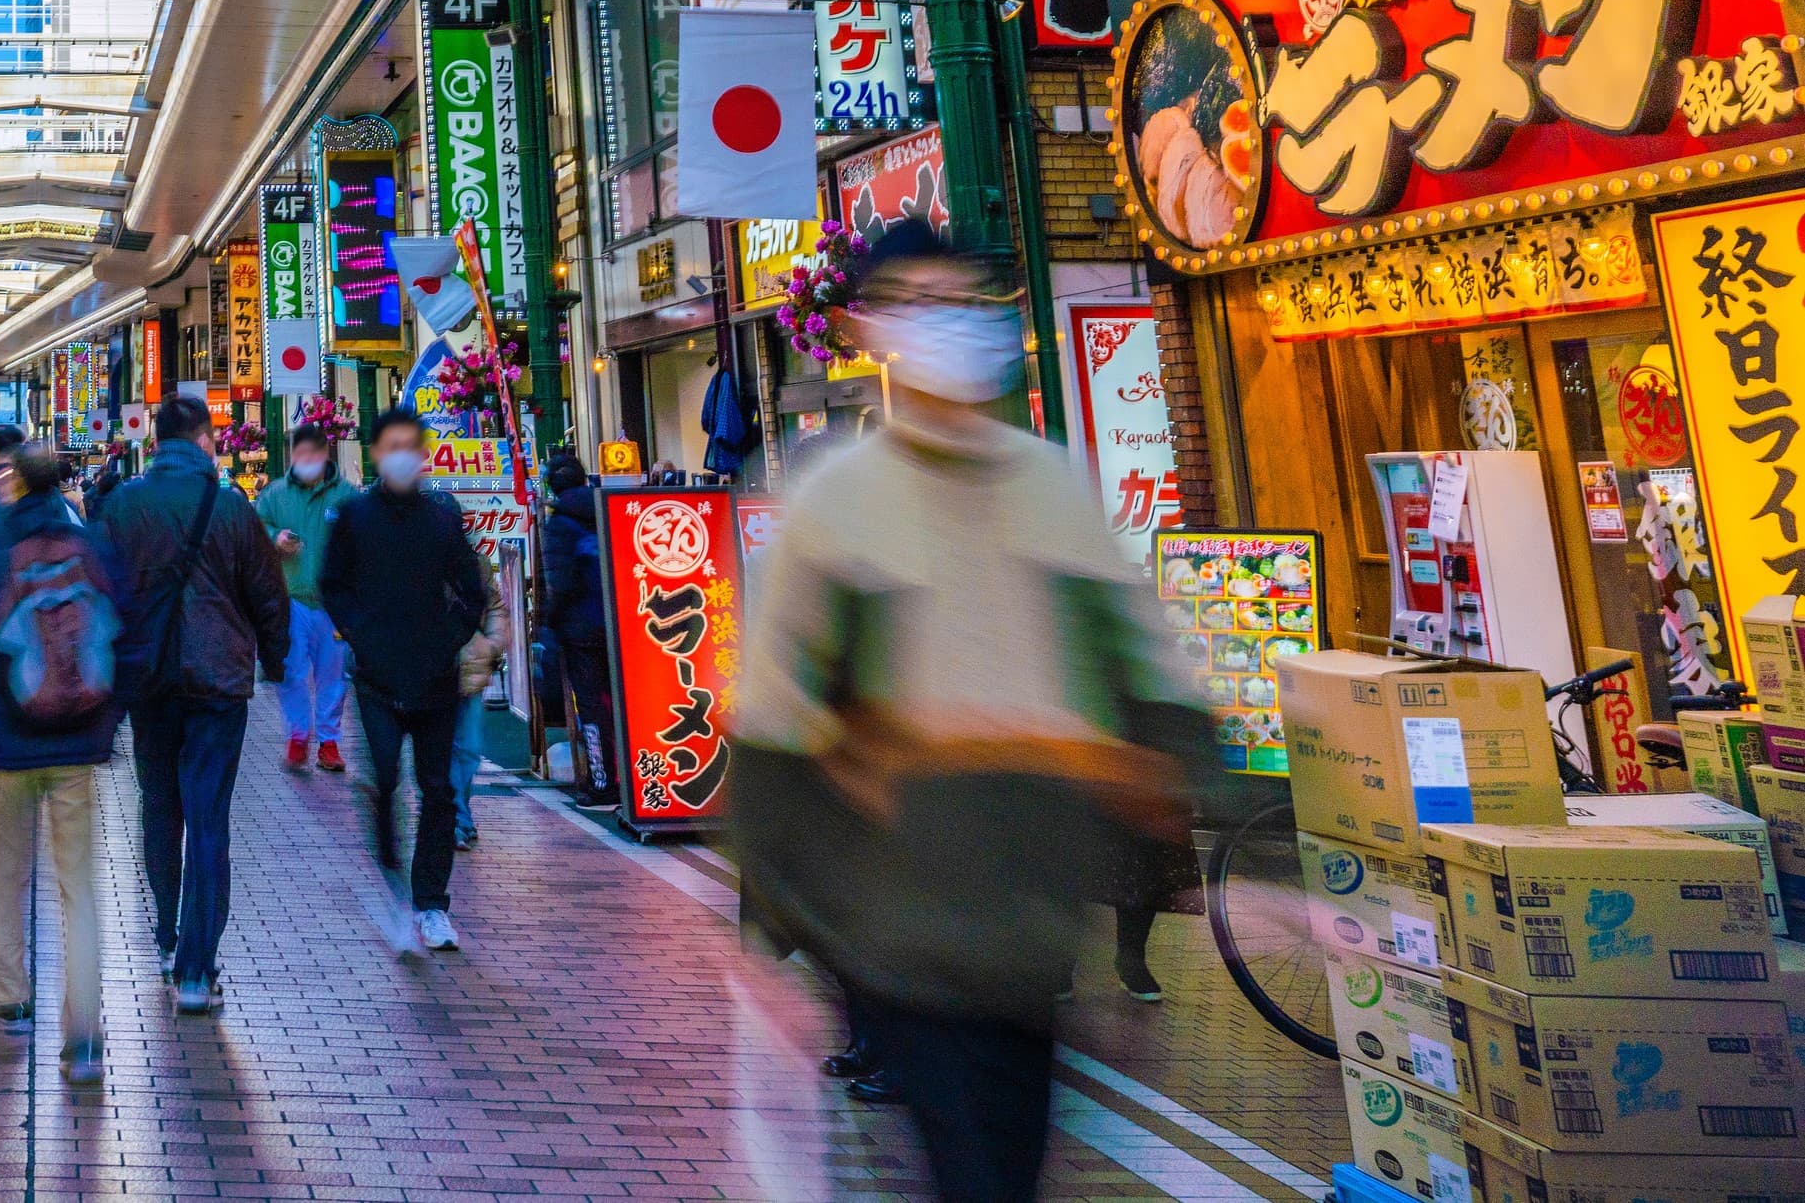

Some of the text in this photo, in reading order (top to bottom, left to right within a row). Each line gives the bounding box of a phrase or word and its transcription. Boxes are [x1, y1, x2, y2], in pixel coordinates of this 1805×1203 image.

[828, 79, 900, 117] 24h
[1677, 36, 1795, 138] 銀家
[273, 196, 306, 222] 4F
[274, 270, 297, 319] BAA
[234, 296, 253, 377] アカマル屋
[240, 386, 254, 399] 1F
[704, 577, 743, 716] 横浜家系
[638, 579, 731, 810] ラーメン
[636, 749, 671, 811] 銀家
